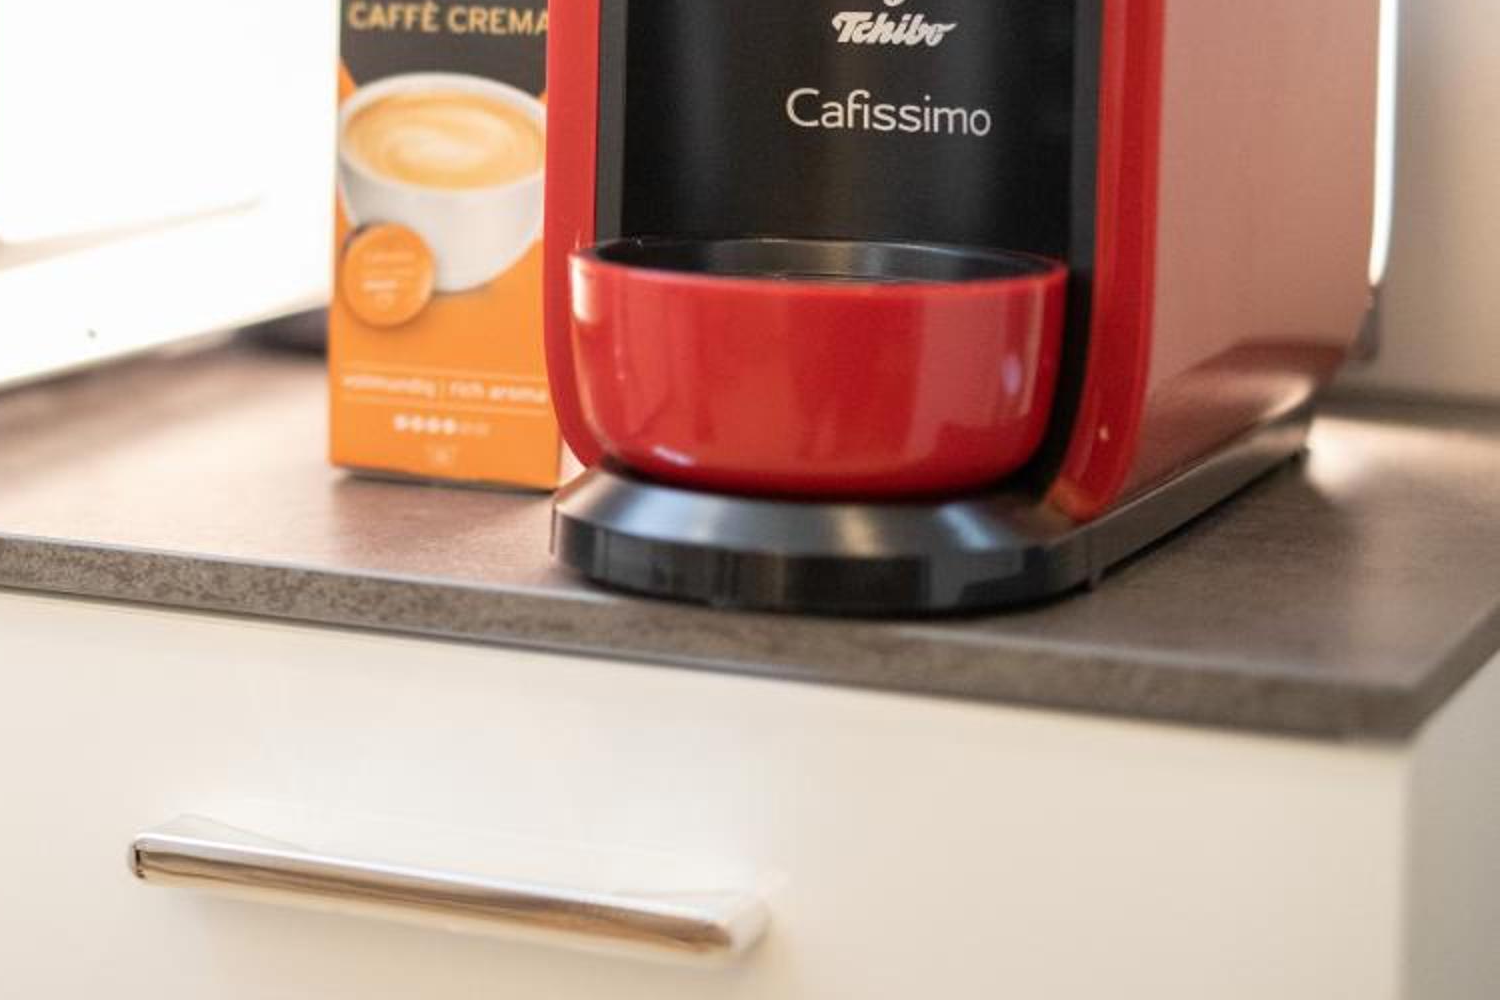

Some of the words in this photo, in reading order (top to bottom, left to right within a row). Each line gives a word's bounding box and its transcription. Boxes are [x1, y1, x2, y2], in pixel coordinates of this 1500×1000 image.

[348, 0, 441, 33] CAFFÈ
[831, 11, 957, 47] Tchibo
[786, 88, 991, 136] Cafissimo
